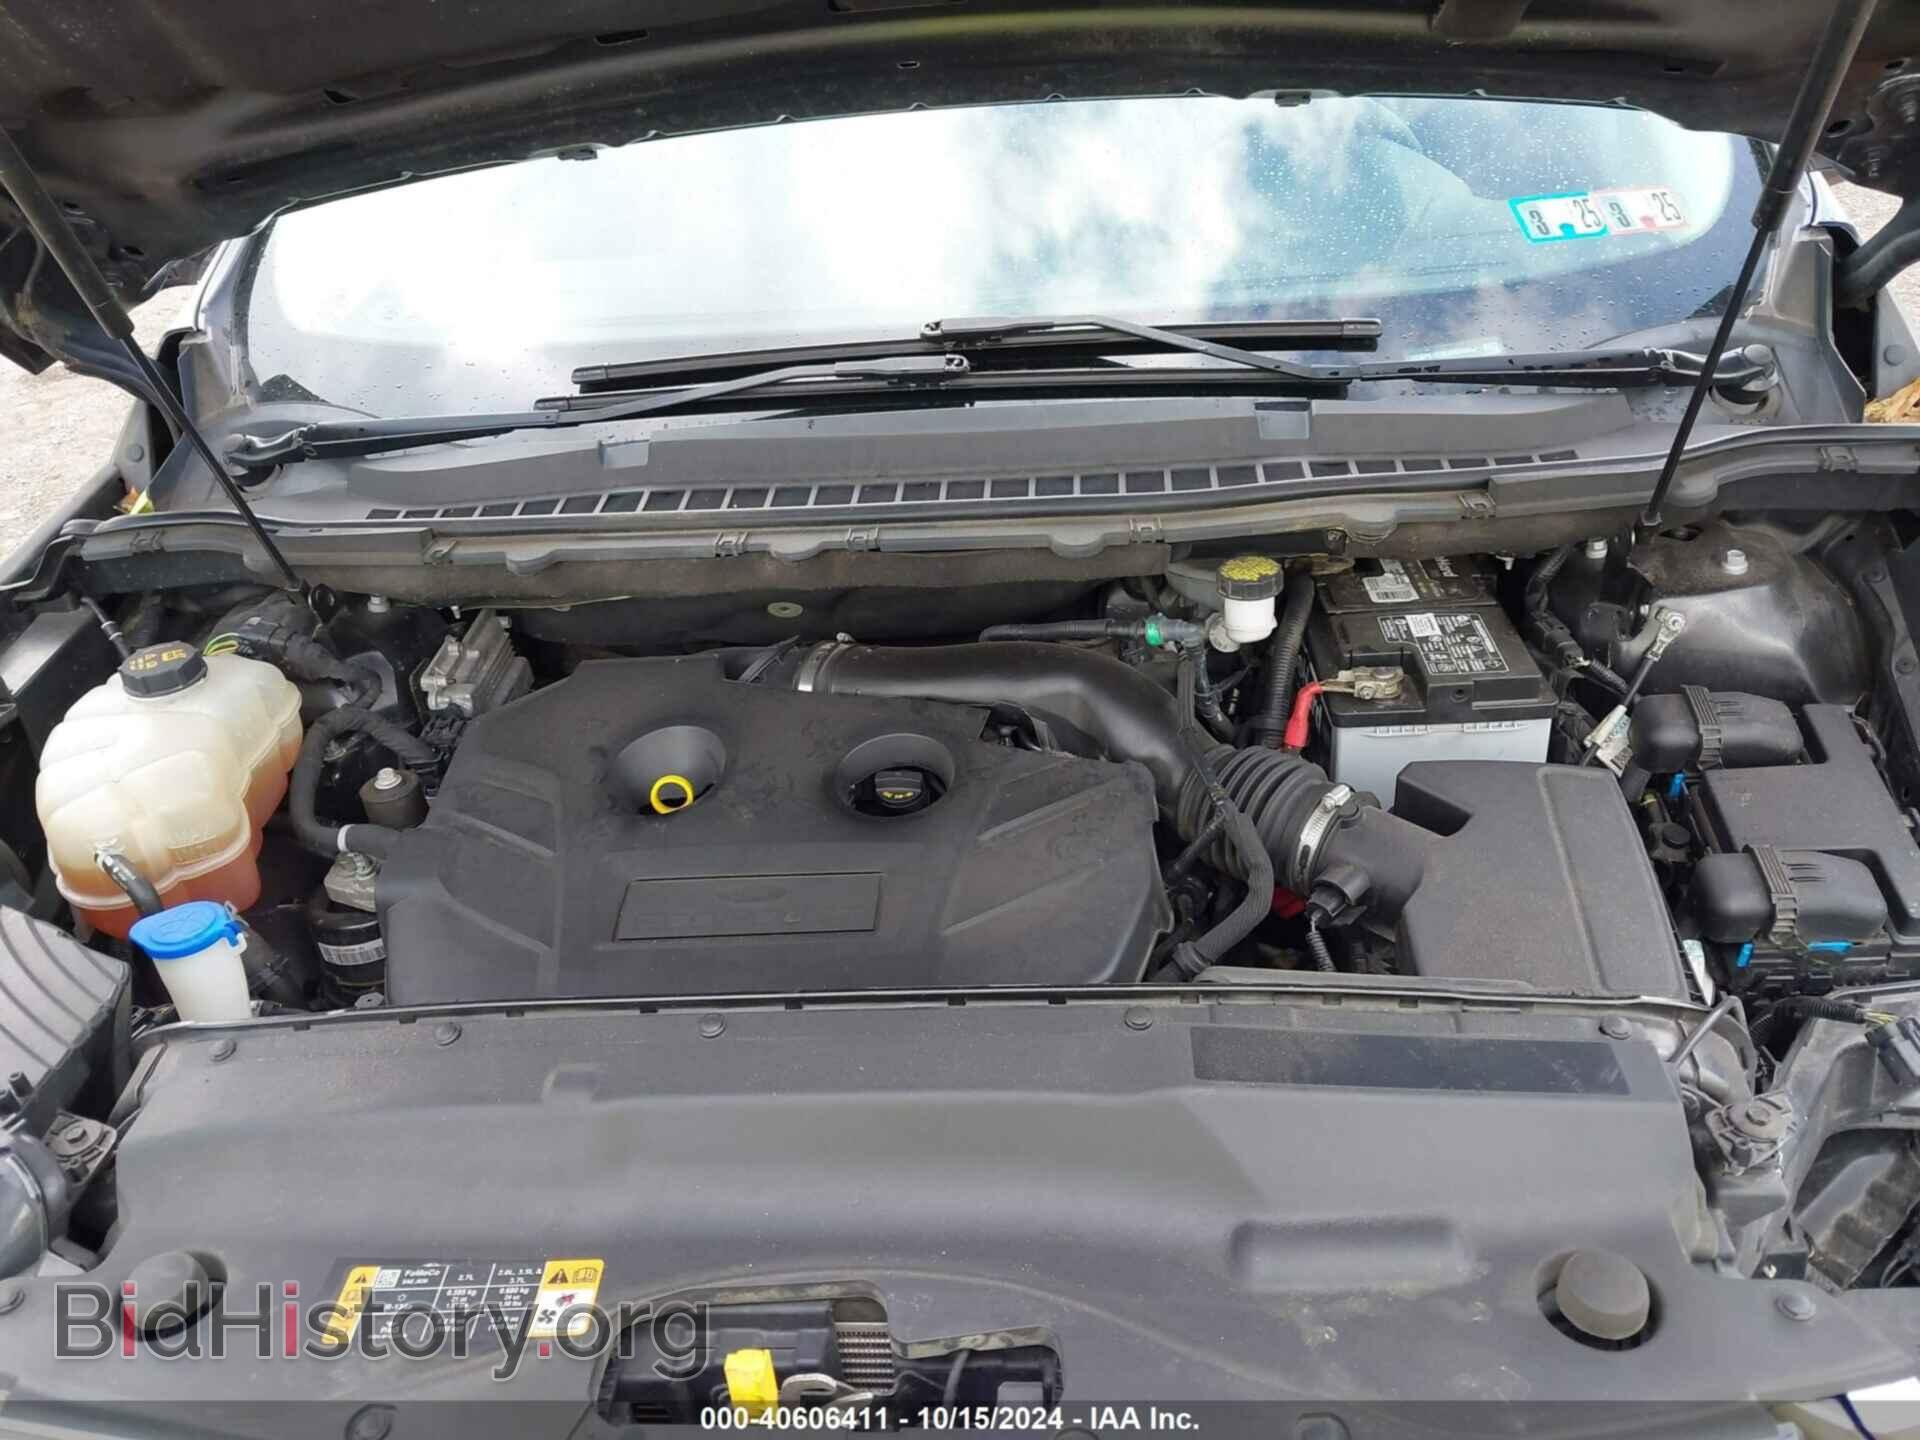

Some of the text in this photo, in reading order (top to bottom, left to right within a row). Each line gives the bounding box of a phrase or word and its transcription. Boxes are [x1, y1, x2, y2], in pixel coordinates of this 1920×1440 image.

[1529, 198, 1601, 235] 3 25
[1609, 191, 1682, 228] 3 25
